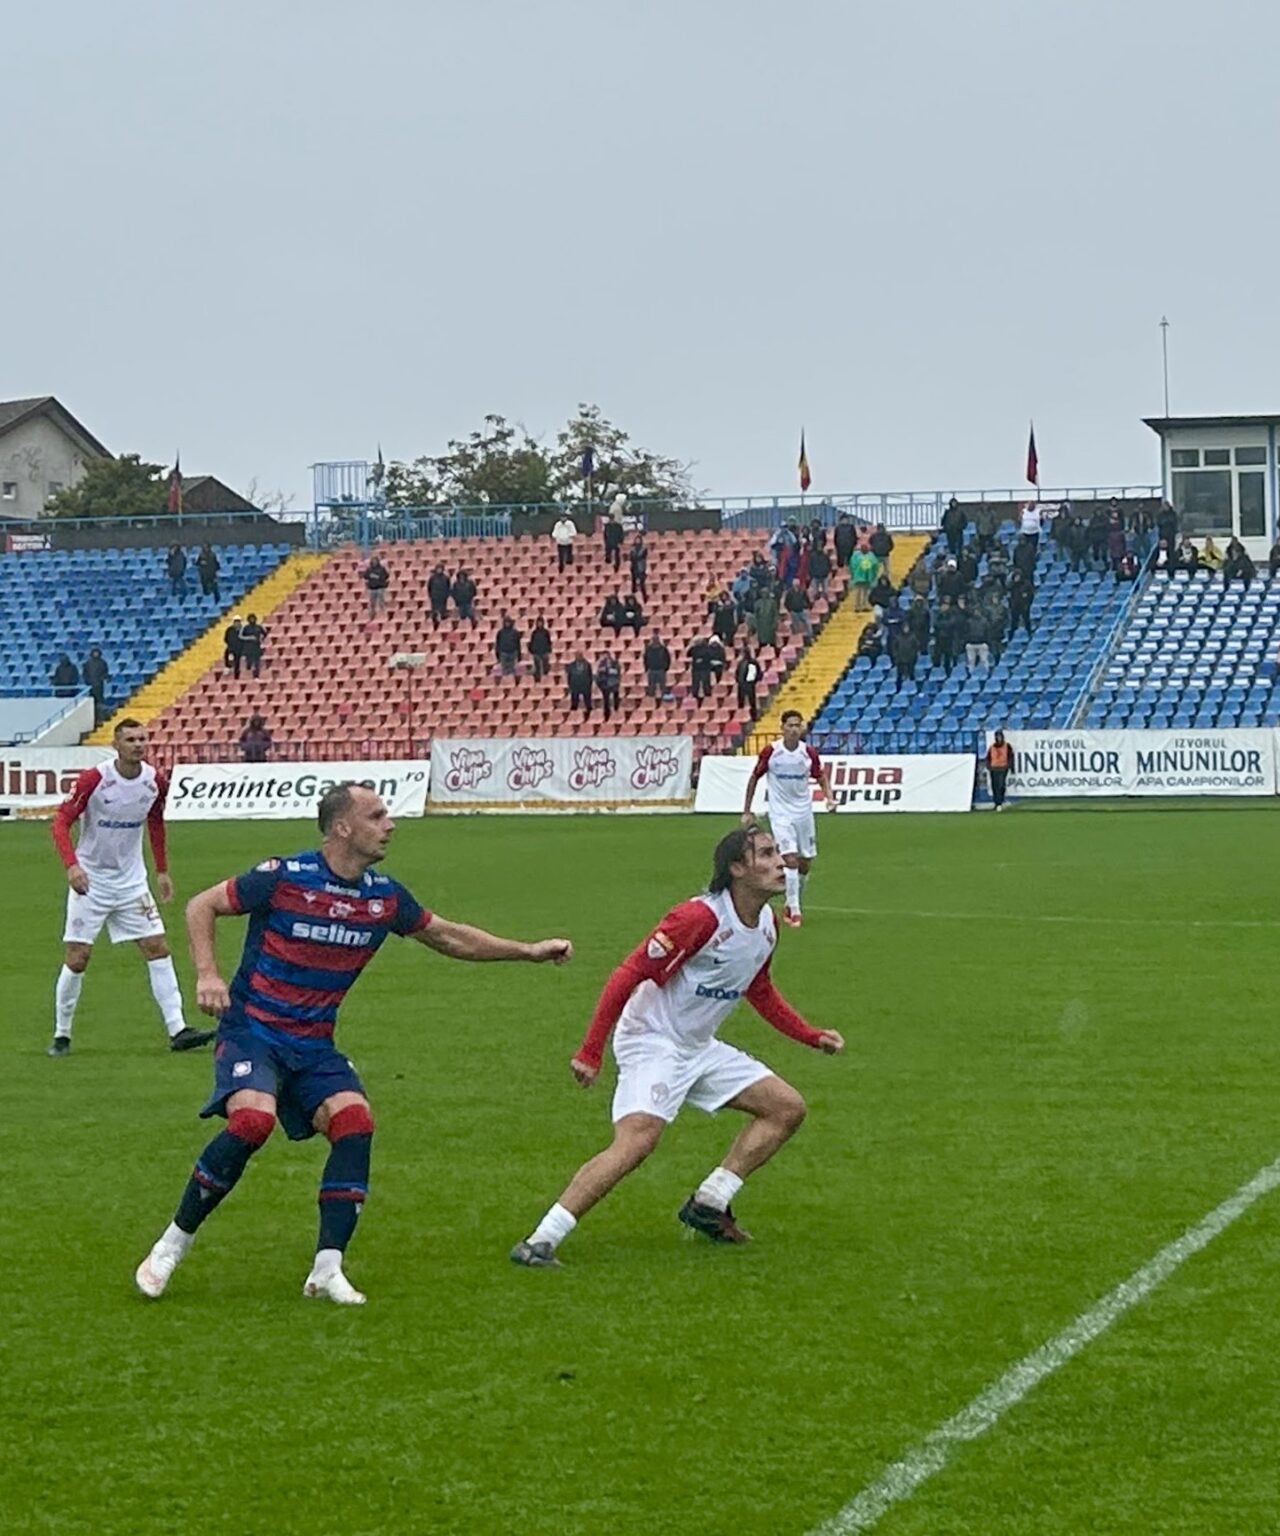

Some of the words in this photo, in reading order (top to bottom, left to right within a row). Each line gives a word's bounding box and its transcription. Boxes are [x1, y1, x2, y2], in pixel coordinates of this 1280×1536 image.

[1035, 739, 1087, 749] IZVORUL
[1175, 738, 1227, 748] IZVORUL
[1011, 751, 1120, 774] INUNILOR
[1136, 750, 1262, 774] MINUNILOR
[1027, 777, 1122, 787] CAMPIONILOR
[1136, 777, 1163, 787] APA
[1166, 776, 1265, 787] CAMPIONILOR
[833, 789, 902, 805] grup
[292, 923, 373, 945] selina
